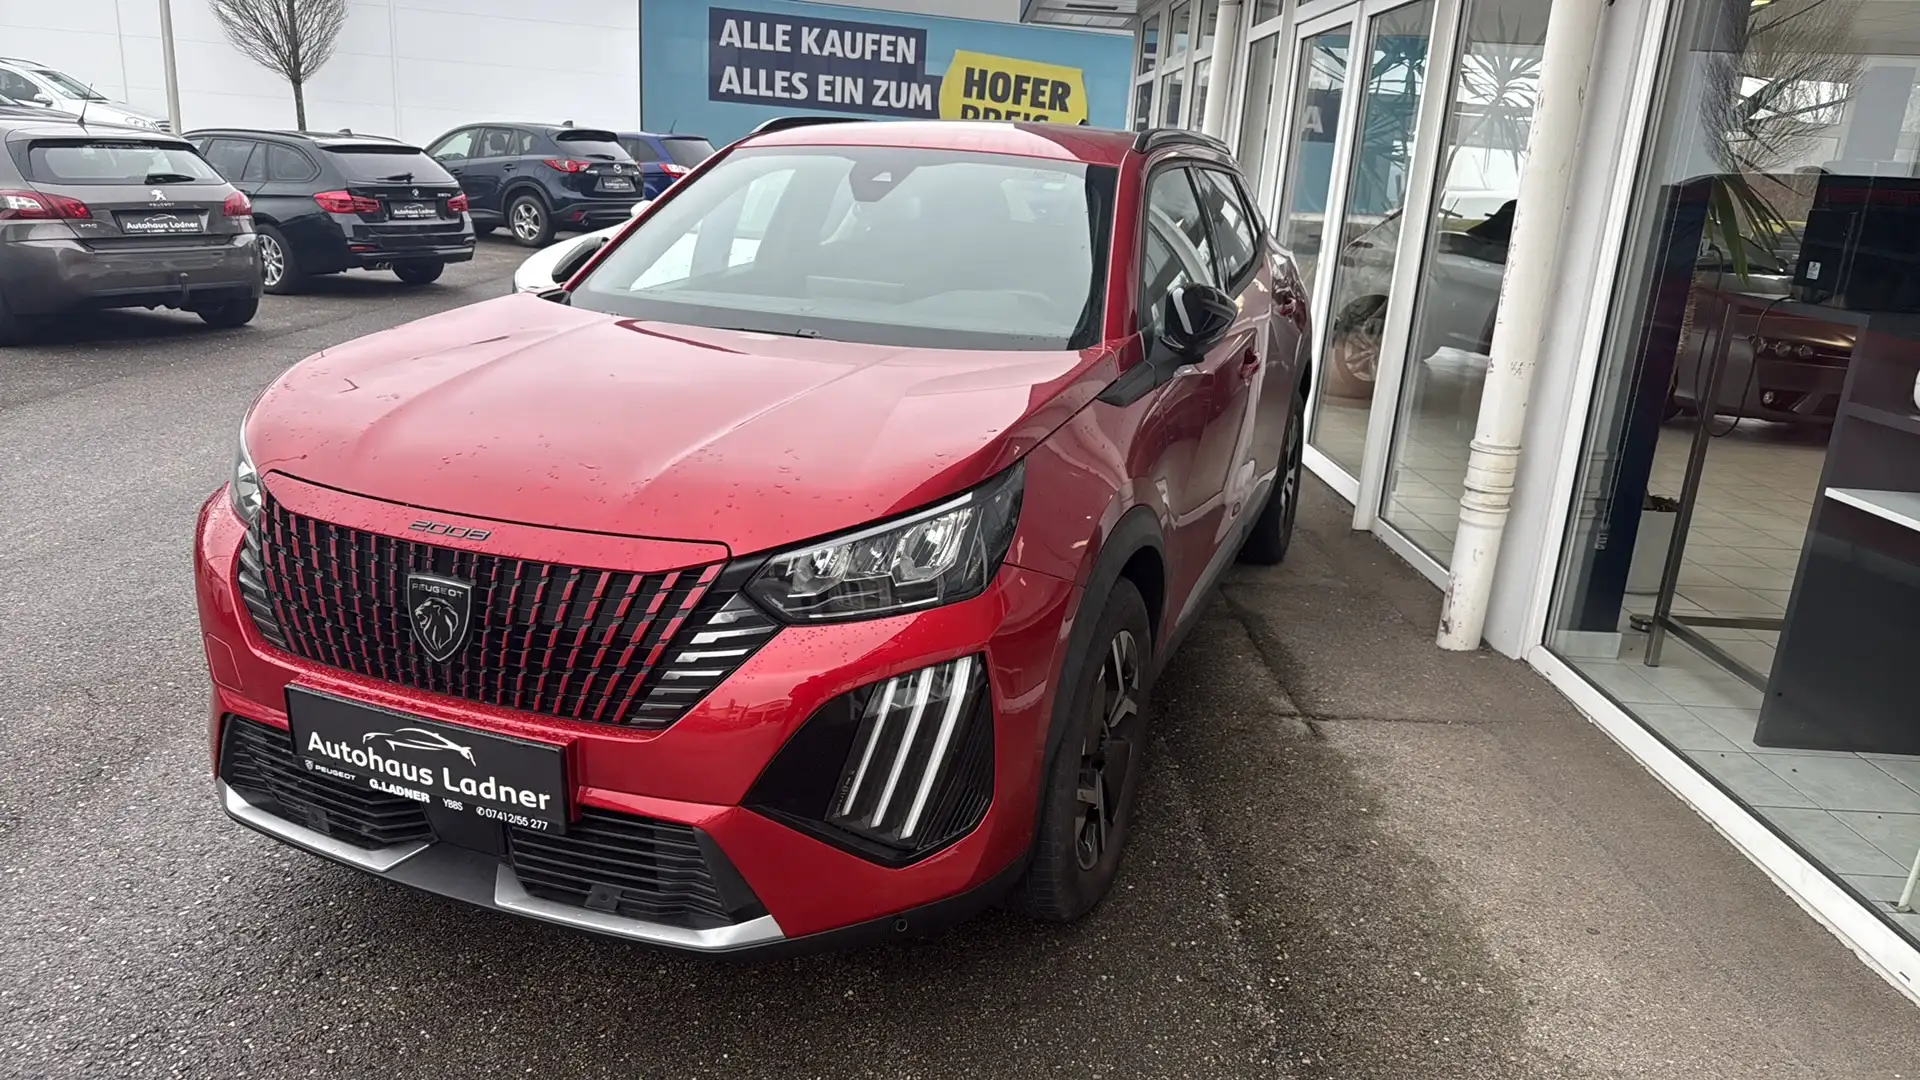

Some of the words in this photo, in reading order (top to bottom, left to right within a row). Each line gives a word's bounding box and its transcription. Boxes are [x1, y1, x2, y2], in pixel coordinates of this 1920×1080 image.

[719, 18, 792, 53] ALLE
[801, 26, 916, 65] KAUFEN
[719, 65, 808, 100] ALLES
[817, 74, 863, 105] EIN
[872, 79, 932, 111] ZUM
[963, 66, 1071, 113] HOFER
[126, 221, 168, 230] Autohaus
[169, 221, 198, 229] Ladner
[408, 519, 492, 542] 2008
[411, 582, 464, 599] PEUGEOT
[307, 731, 434, 786] Autohaus
[443, 766, 550, 810] Ladner
[315, 764, 356, 781] PEUGEOT
[369, 778, 431, 804] G.LADNER
[442, 798, 463, 812] YBBS
[485, 808, 529, 826] 07412/55
[530, 818, 549, 831] 277
